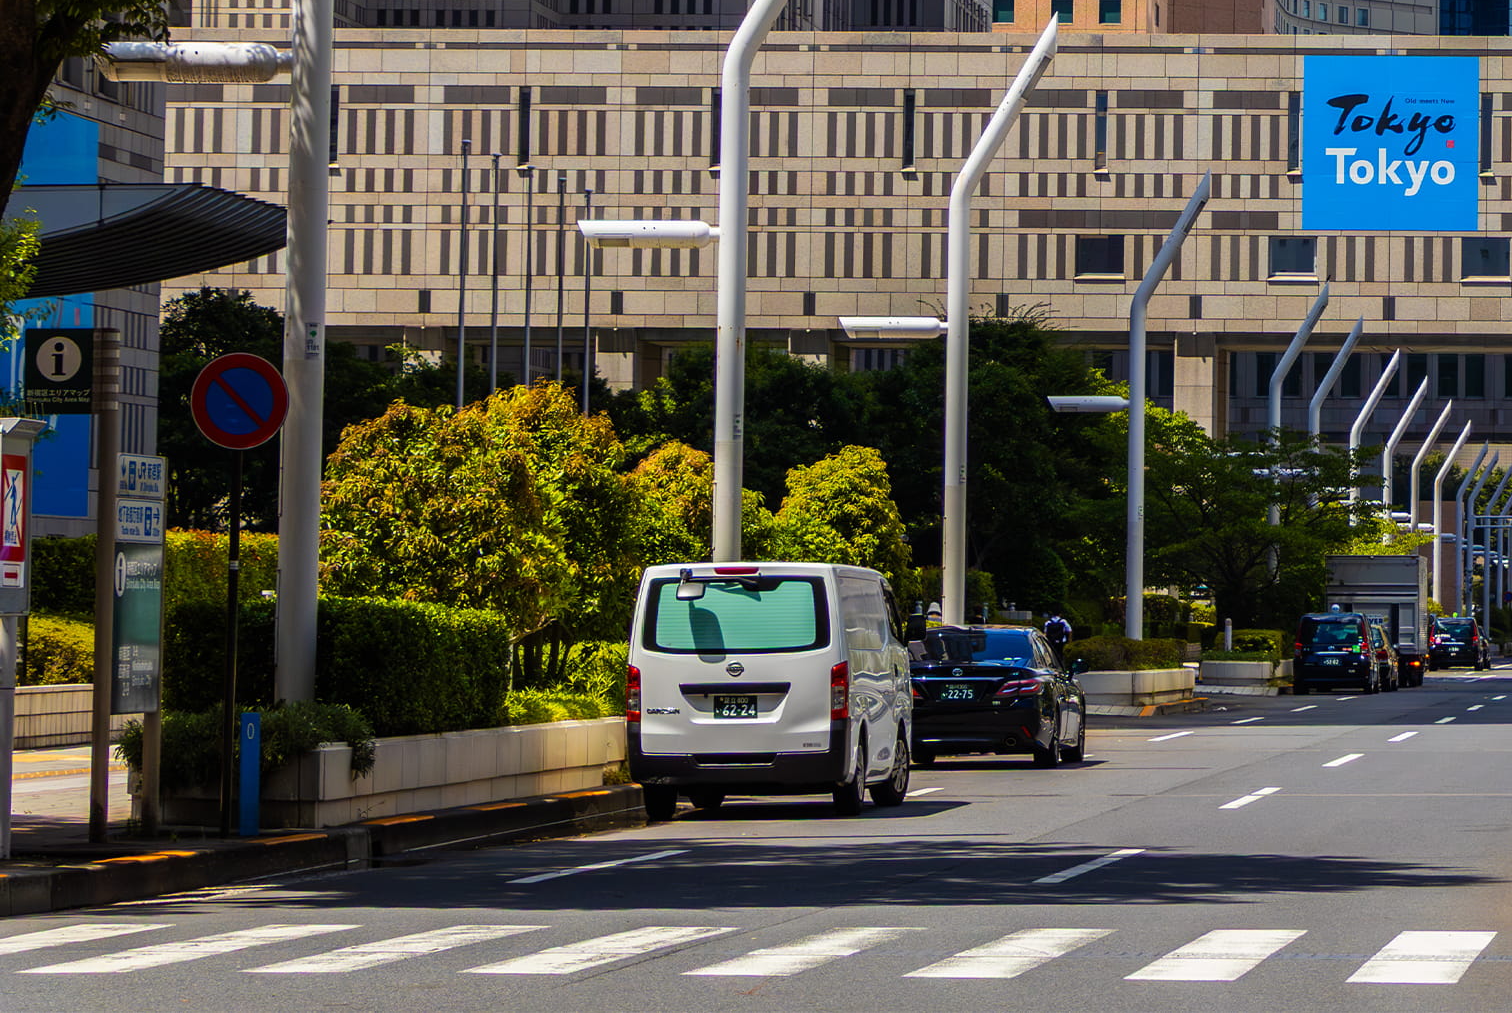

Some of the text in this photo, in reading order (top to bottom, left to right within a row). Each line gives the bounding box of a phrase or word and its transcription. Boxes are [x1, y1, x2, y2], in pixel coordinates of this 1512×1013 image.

[1326, 93, 1456, 156] Tokyo
[1325, 148, 1455, 196] Tokyo
[948, 689, 973, 699] 22-75
[722, 704, 756, 716] 62-24
